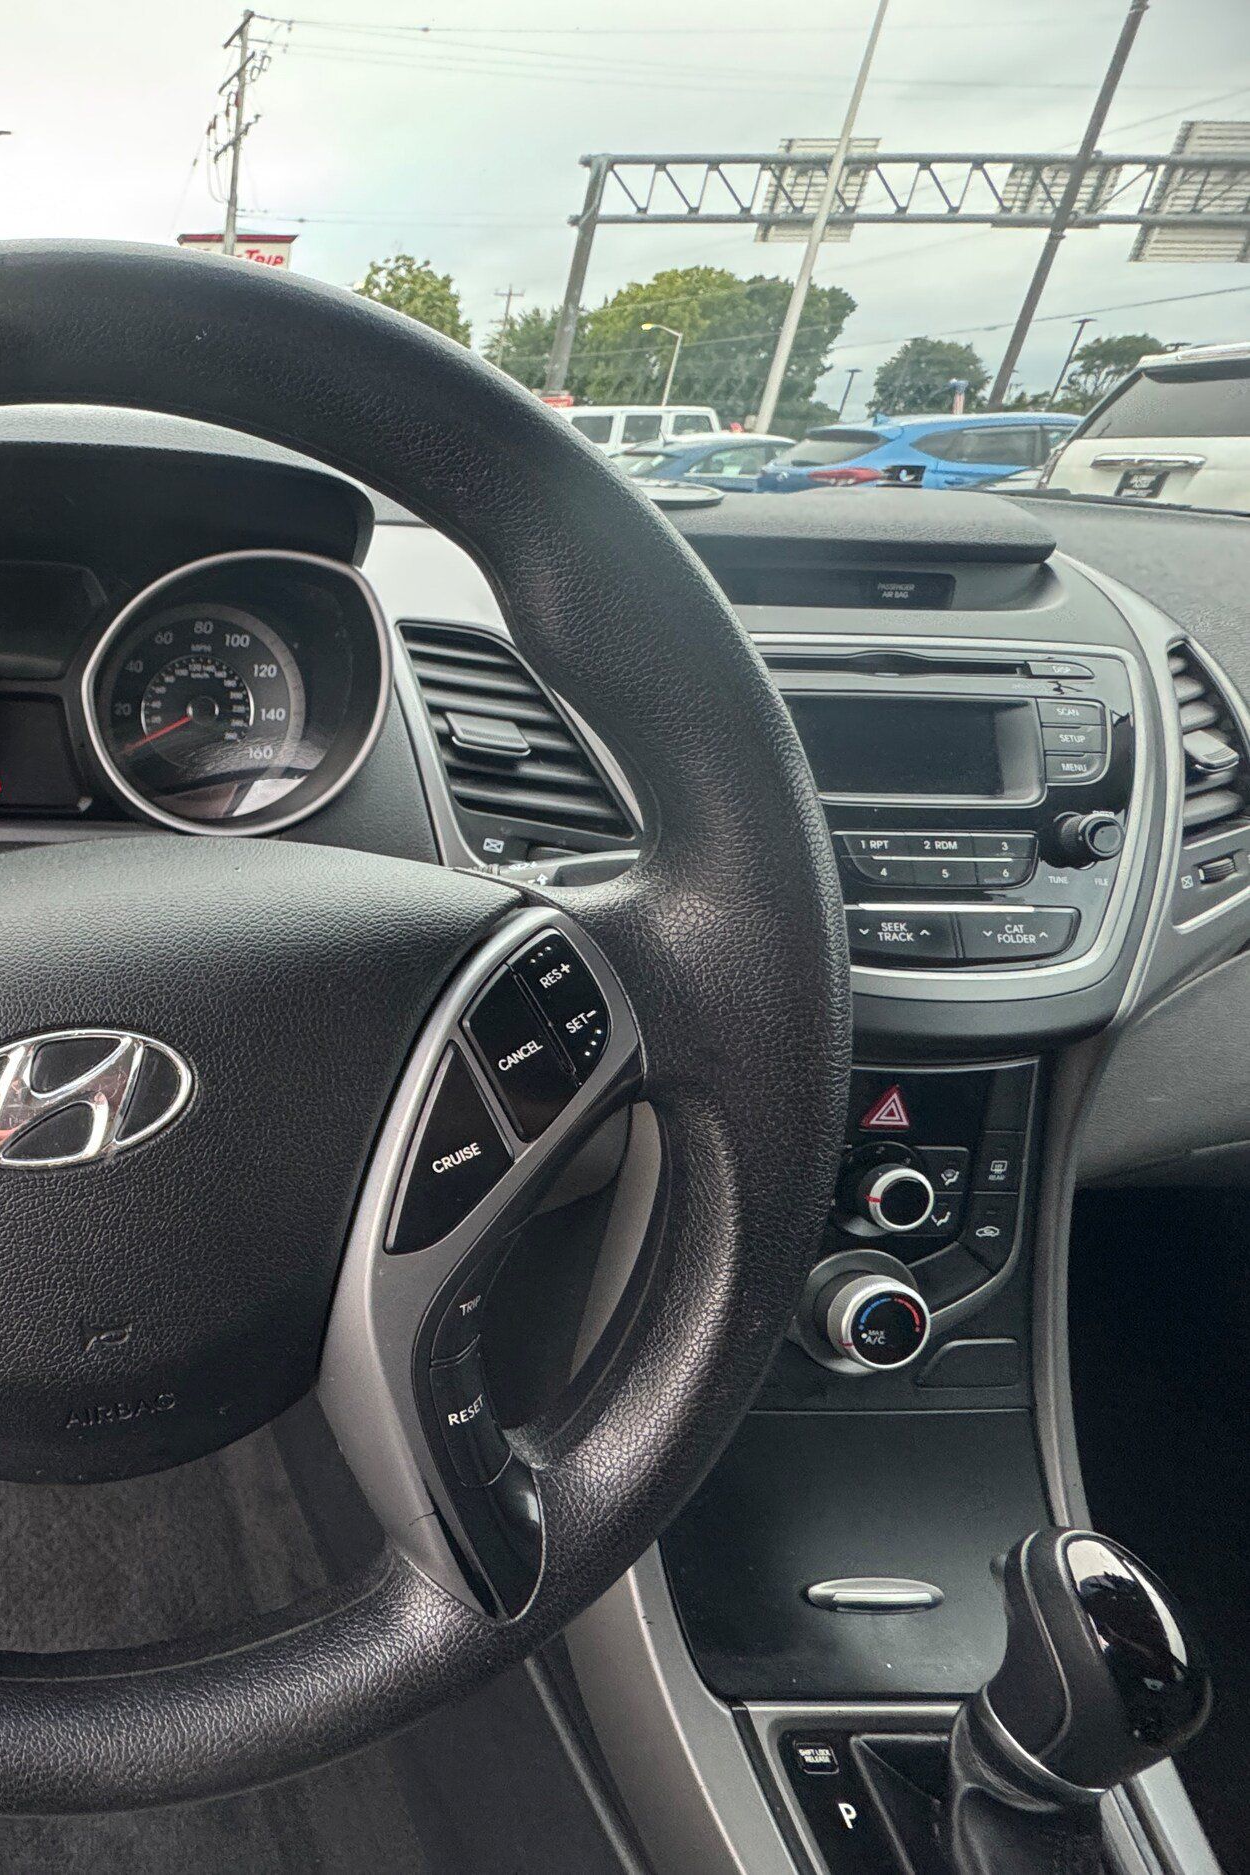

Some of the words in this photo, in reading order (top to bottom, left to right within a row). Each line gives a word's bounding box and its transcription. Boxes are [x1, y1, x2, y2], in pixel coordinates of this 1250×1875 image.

[194, 620, 214, 636] 80
[155, 631, 174, 645] 60
[225, 634, 250, 648] 100
[125, 659, 144, 673] 40
[253, 663, 278, 678] 120
[114, 702, 132, 716] 20
[260, 707, 286, 722] 140
[1056, 708, 1080, 716] SCAN
[1059, 734, 1086, 743] SETUP
[249, 748, 274, 759] 160
[1061, 763, 1087, 772] MENU
[869, 840, 889, 850] RPT
[923, 840, 931, 849] 2
[934, 841, 958, 850] RDM
[1001, 841, 1009, 851] 3
[880, 867, 888, 877] 4
[942, 869, 950, 879] 5
[1002, 869, 1009, 878] 6
[1048, 876, 1069, 884] TUNE
[881, 922, 907, 932] SEEK
[1004, 924, 1025, 934] CAT
[877, 931, 915, 942] TRACK
[997, 933, 1037, 944] FOLDER
[498, 1040, 543, 1071] CANCEL
[432, 1142, 481, 1173] CRUISE
[459, 1295, 481, 1316] TRIP
[448, 1394, 484, 1426] RESET
[838, 1803, 857, 1829] P
